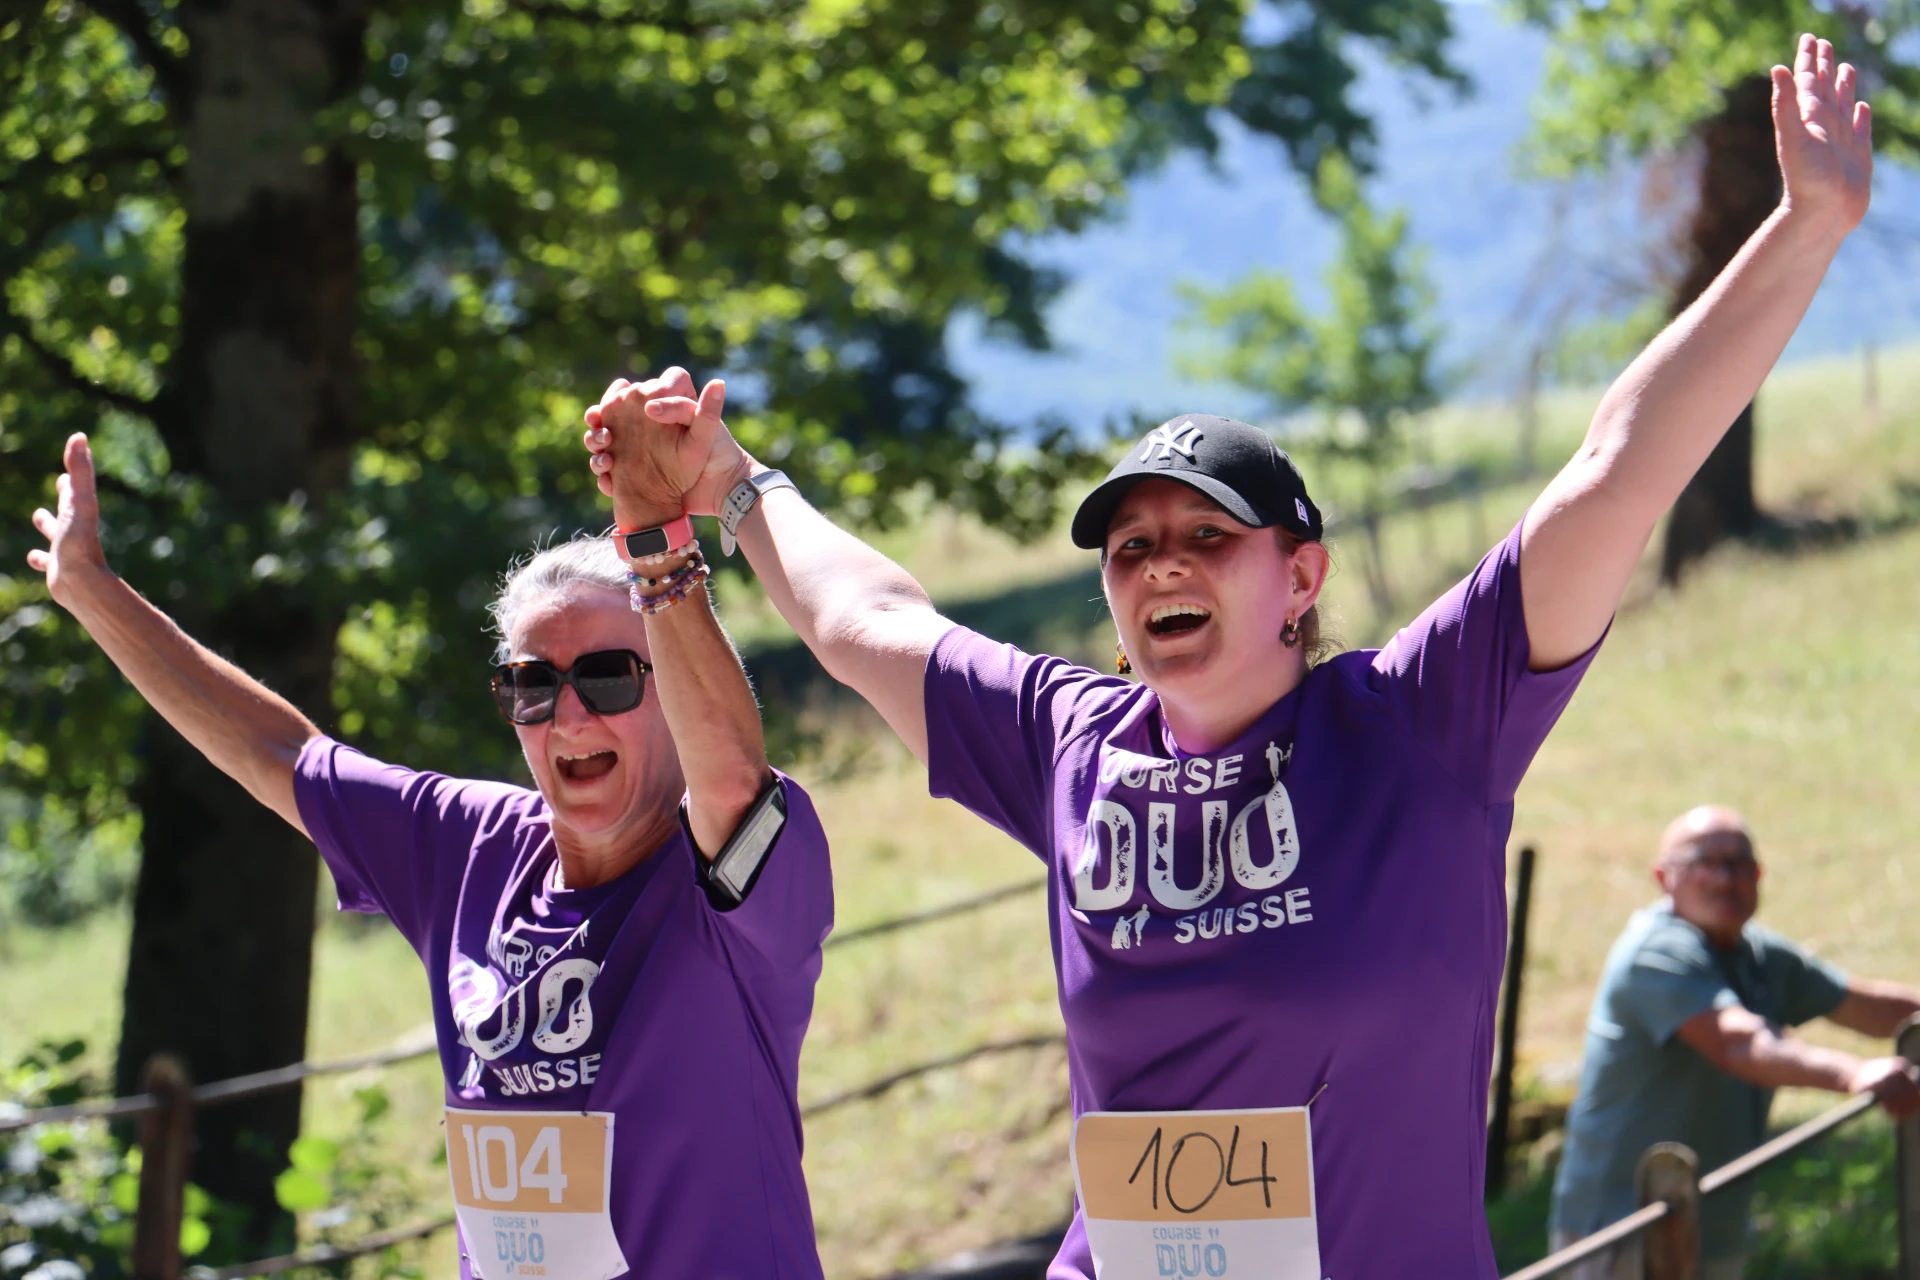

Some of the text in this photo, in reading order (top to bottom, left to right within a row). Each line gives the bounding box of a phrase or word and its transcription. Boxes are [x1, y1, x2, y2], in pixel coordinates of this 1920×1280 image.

[1074, 781, 1300, 911] DUO
[1174, 888, 1313, 944] SUISSE
[461, 1124, 568, 1204] 104
[1129, 1125, 1277, 1213] 104
[495, 1231, 544, 1264] DUO
[1152, 1227, 1202, 1240] COURSE
[1156, 1243, 1227, 1278] DUO
